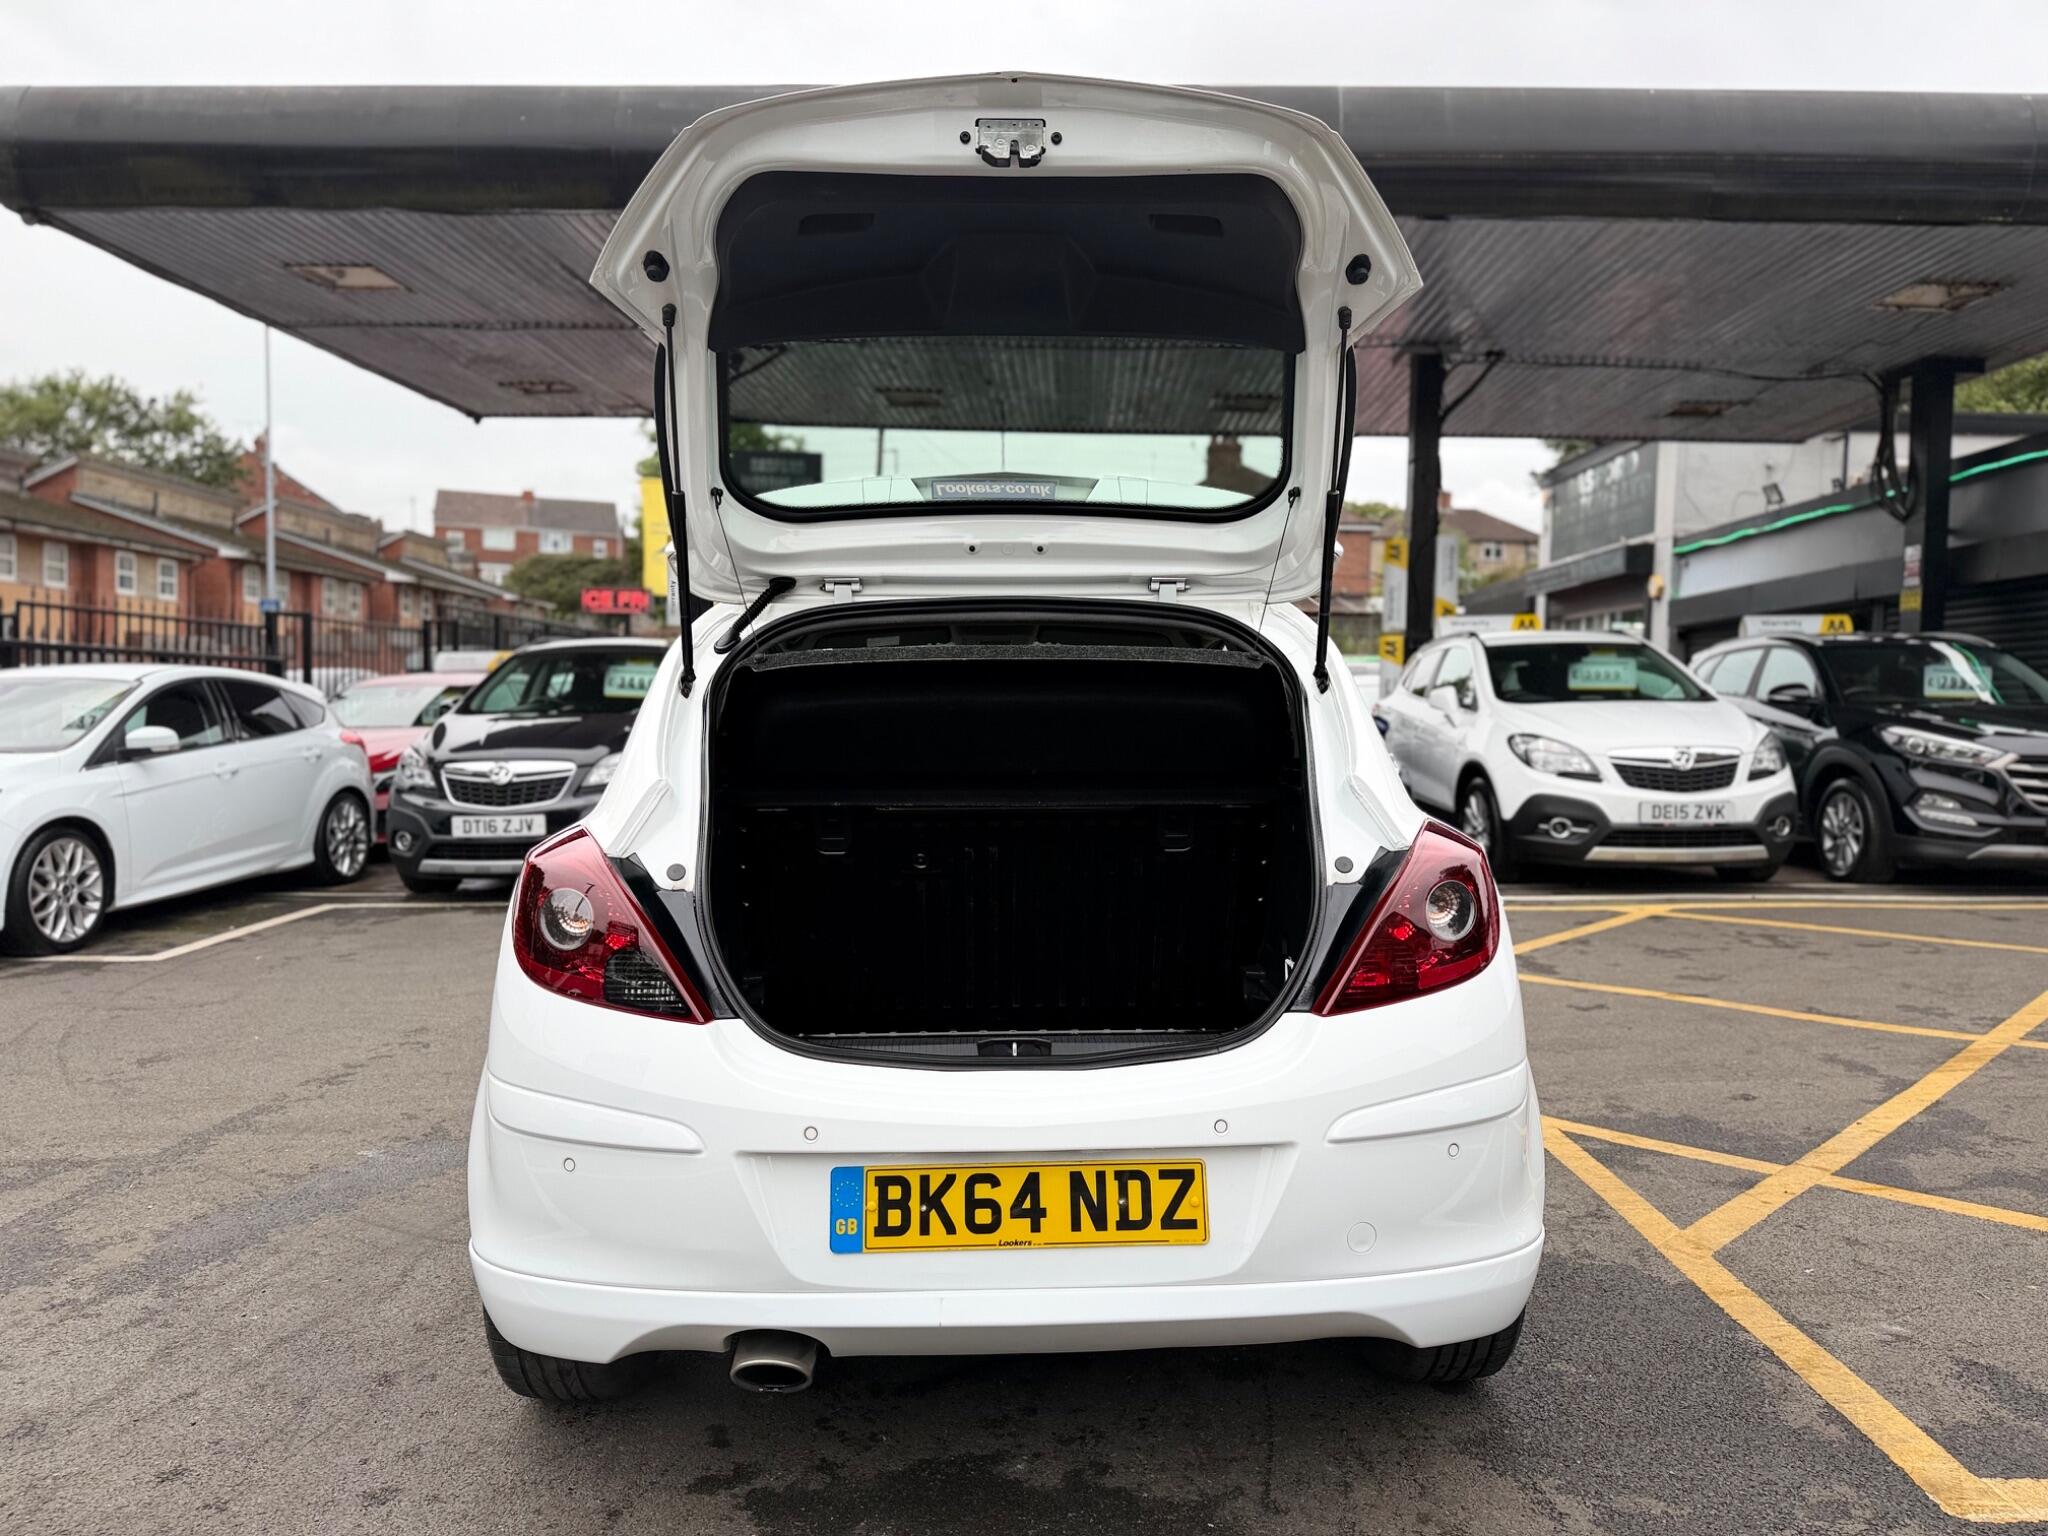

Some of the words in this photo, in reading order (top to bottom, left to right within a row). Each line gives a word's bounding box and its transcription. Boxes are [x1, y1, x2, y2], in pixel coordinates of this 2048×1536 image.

[1517, 619, 1536, 629] AA
[1827, 619, 1847, 632] AA
[1651, 803, 1689, 820] DE15
[1694, 803, 1726, 820] ZVK
[462, 819, 498, 834] DT16
[502, 818, 535, 833] ZJV
[873, 1171, 1047, 1238] BK64
[1069, 1168, 1199, 1233] NDZ
[834, 1217, 859, 1236] GB
[997, 1238, 1033, 1248] Lookers
